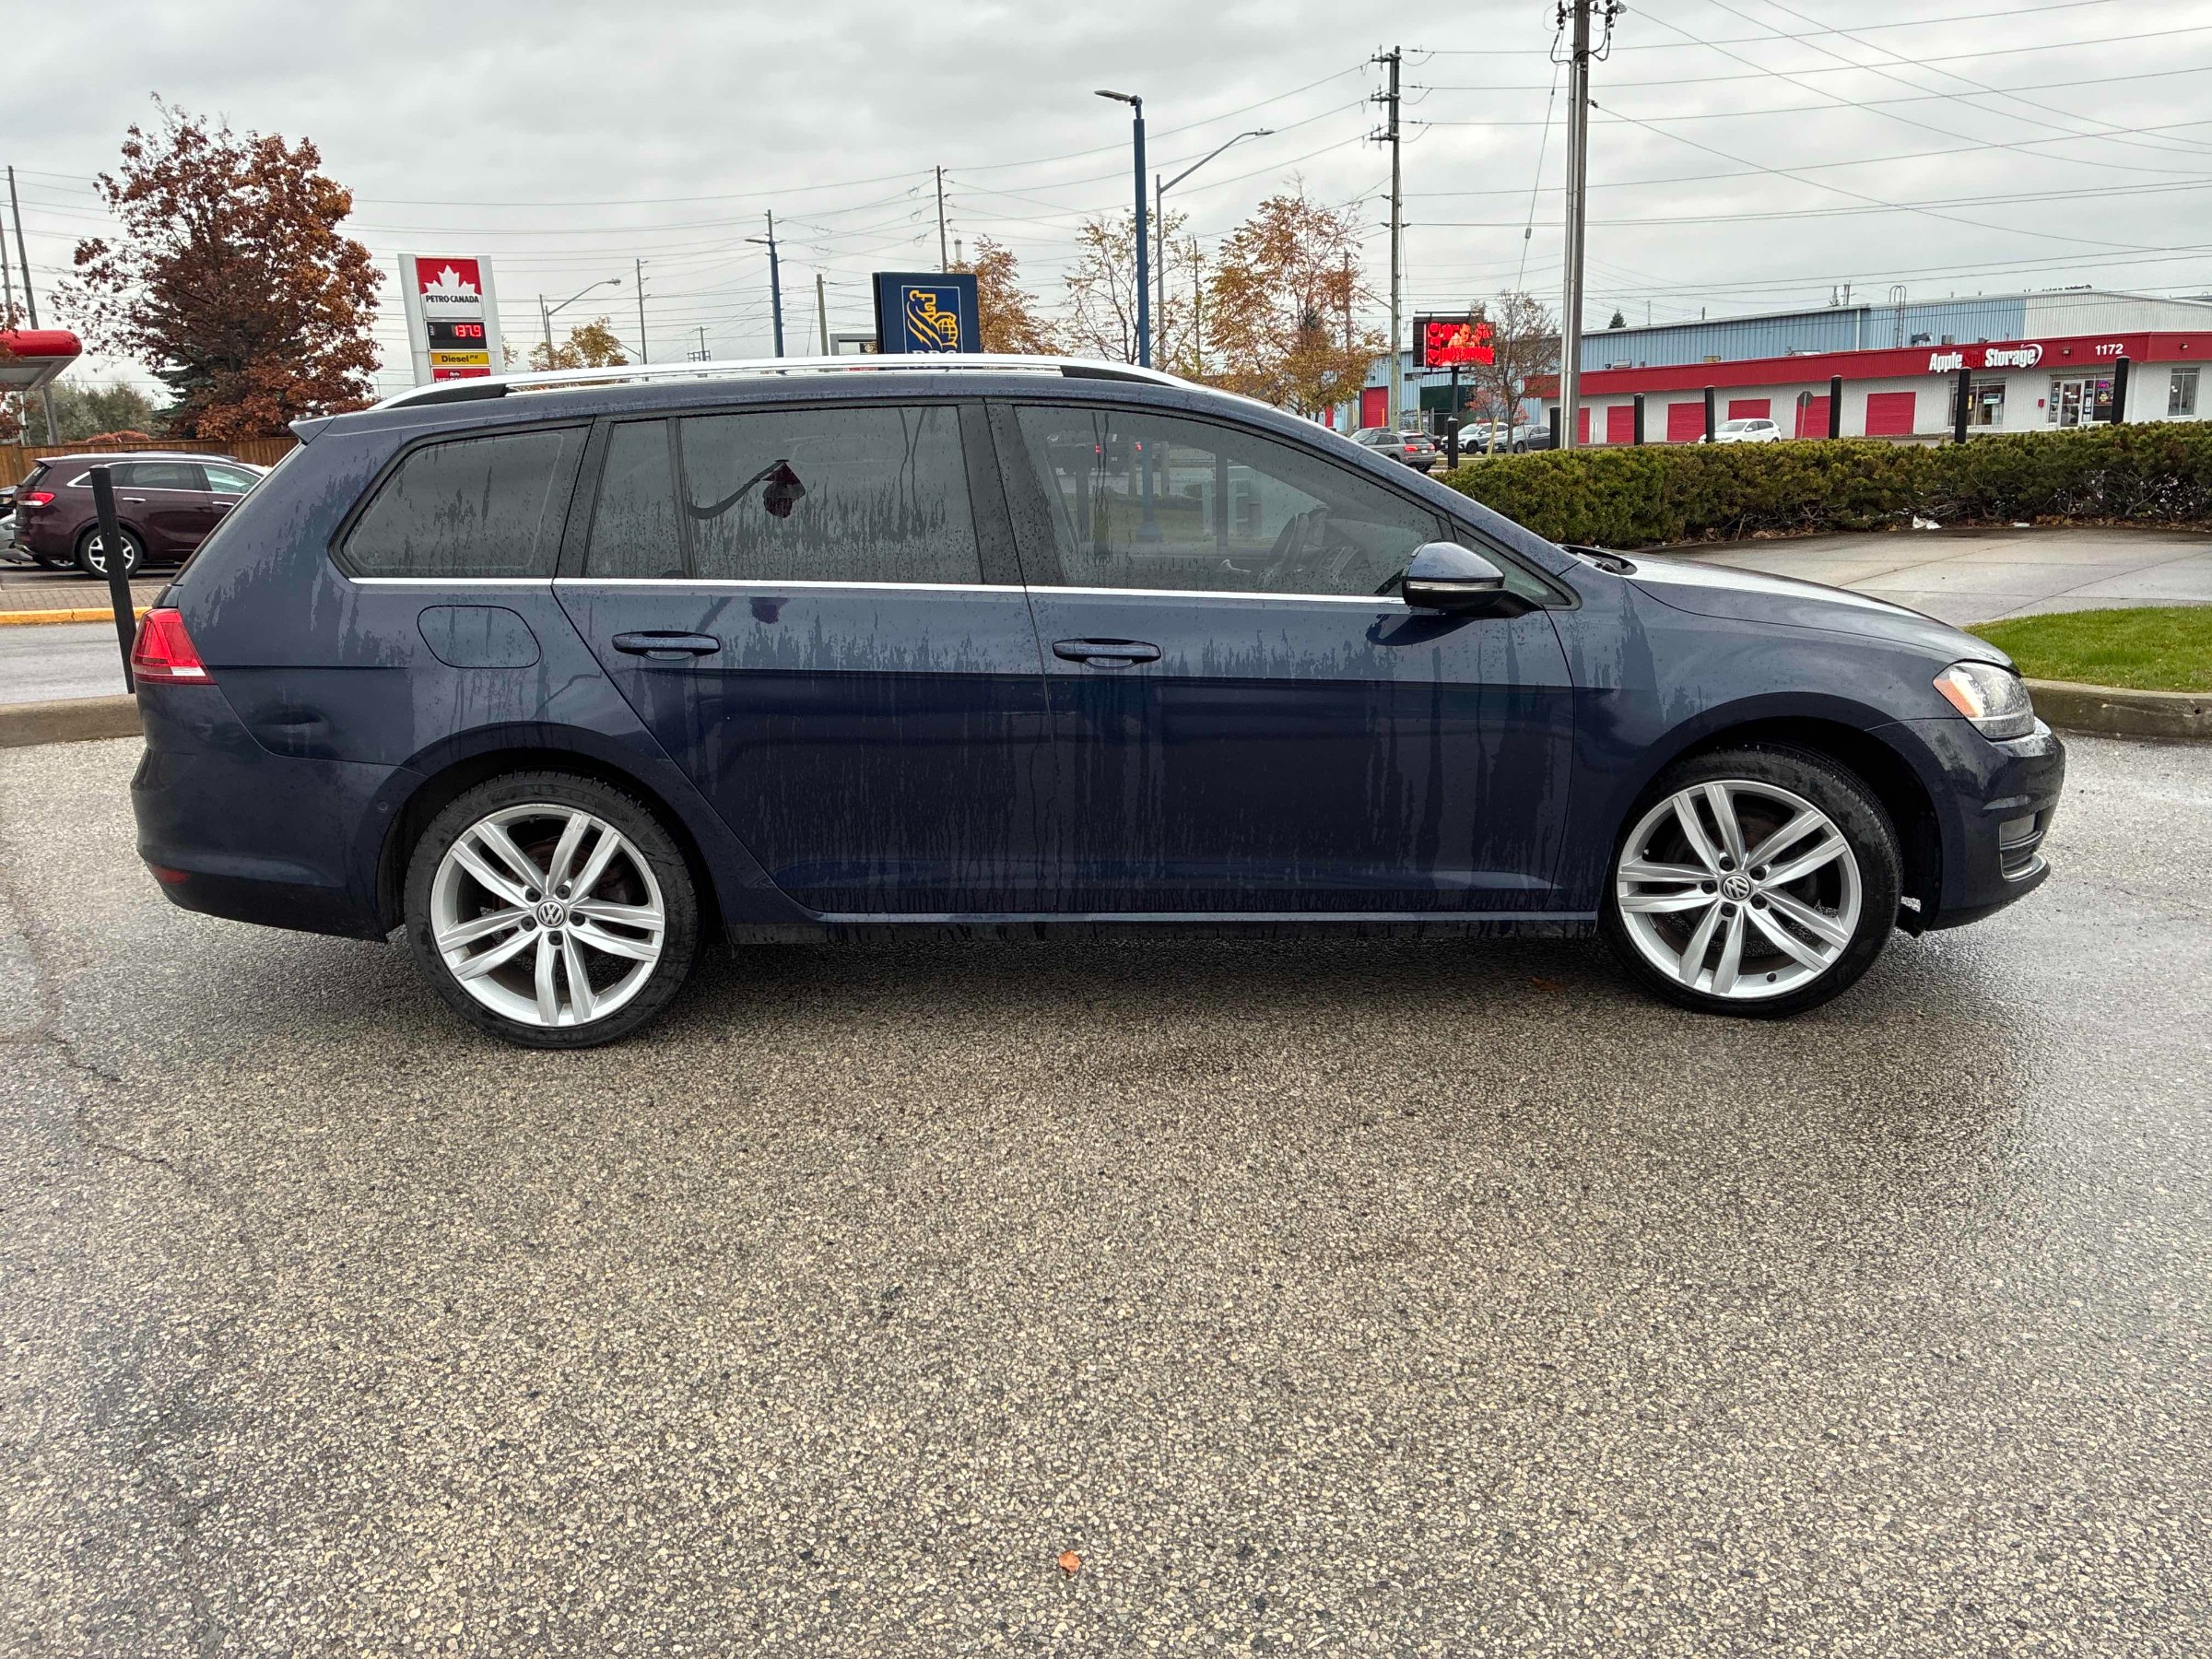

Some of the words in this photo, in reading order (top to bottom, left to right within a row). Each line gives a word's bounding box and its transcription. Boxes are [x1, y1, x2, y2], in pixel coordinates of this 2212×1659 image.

[2095, 343, 2124, 356] 1172
[1929, 352, 1962, 373] Apple
[1984, 348, 2036, 368] Storage
